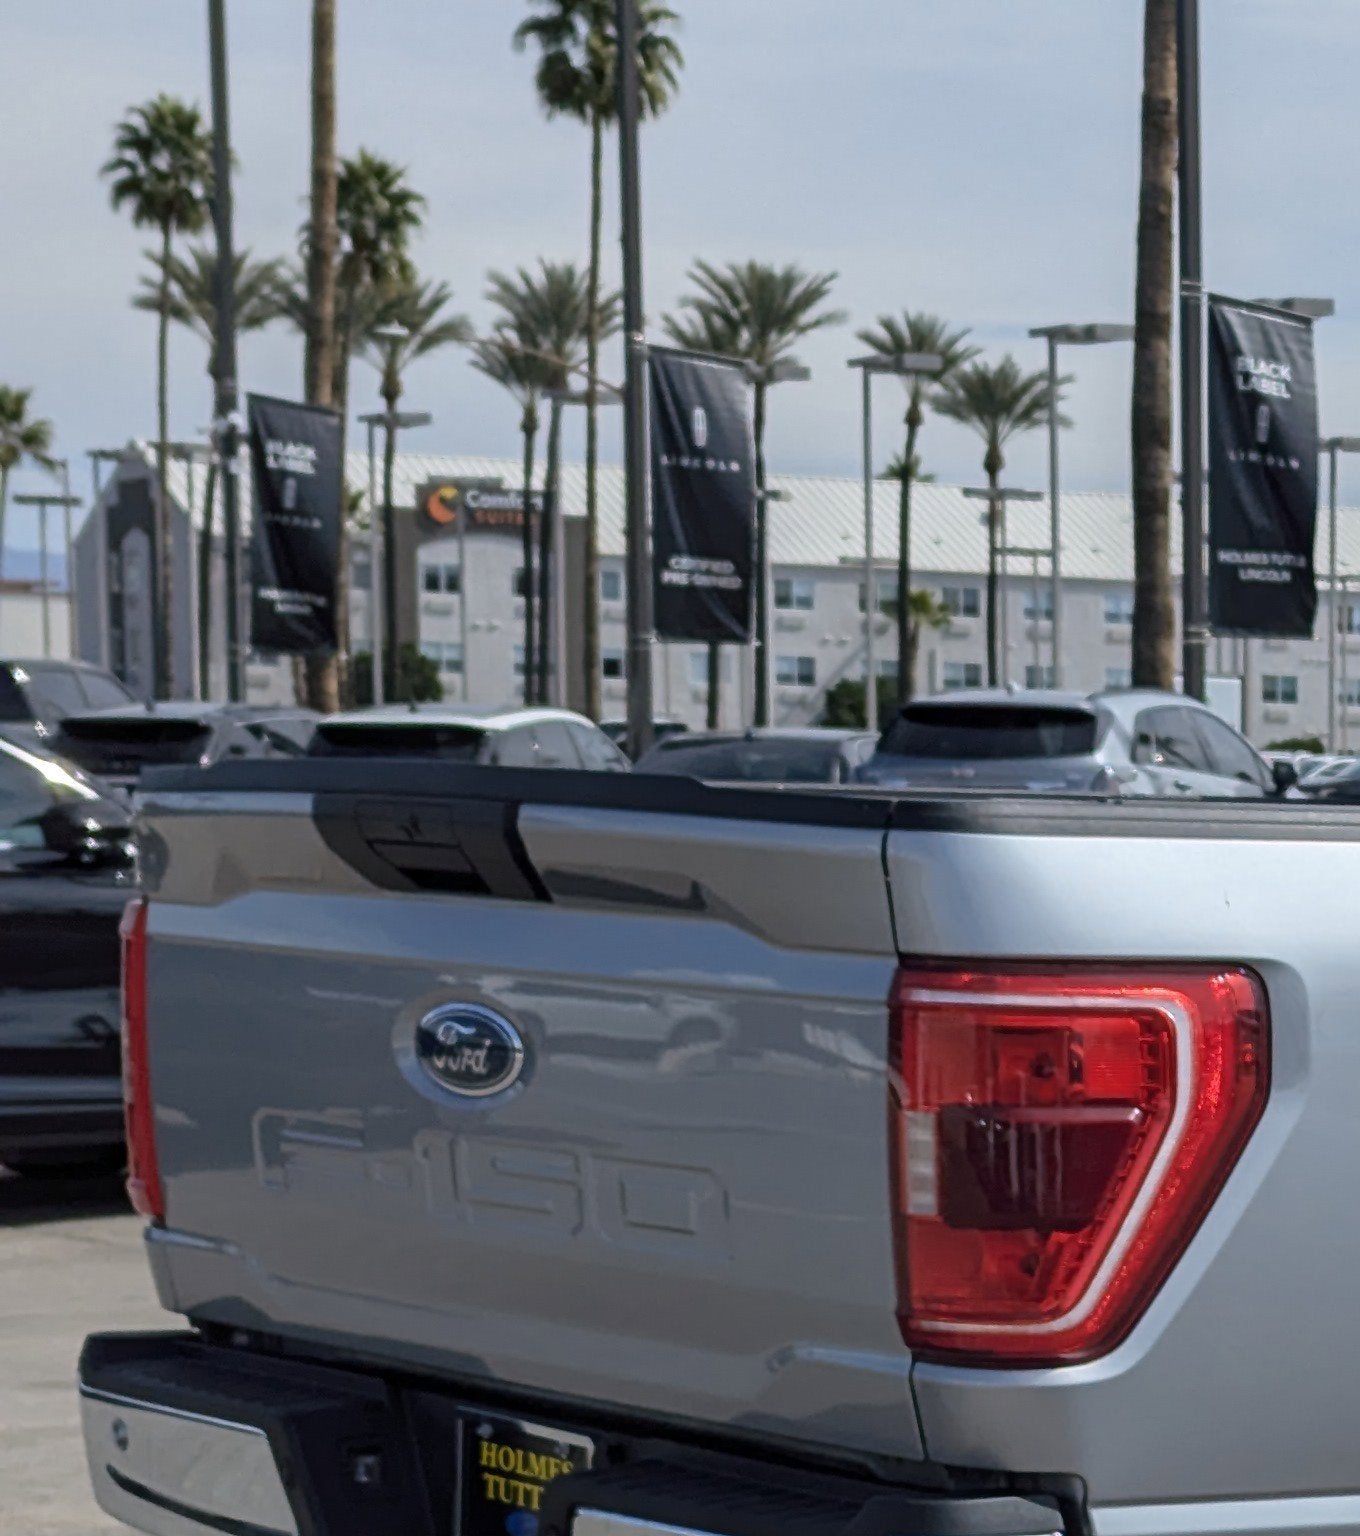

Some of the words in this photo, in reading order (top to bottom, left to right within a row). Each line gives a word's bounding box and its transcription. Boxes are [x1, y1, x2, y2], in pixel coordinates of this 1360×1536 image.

[1237, 356, 1292, 382] BLACK
[1236, 373, 1291, 399] LABEL
[481, 1471, 546, 1512] TUTT
